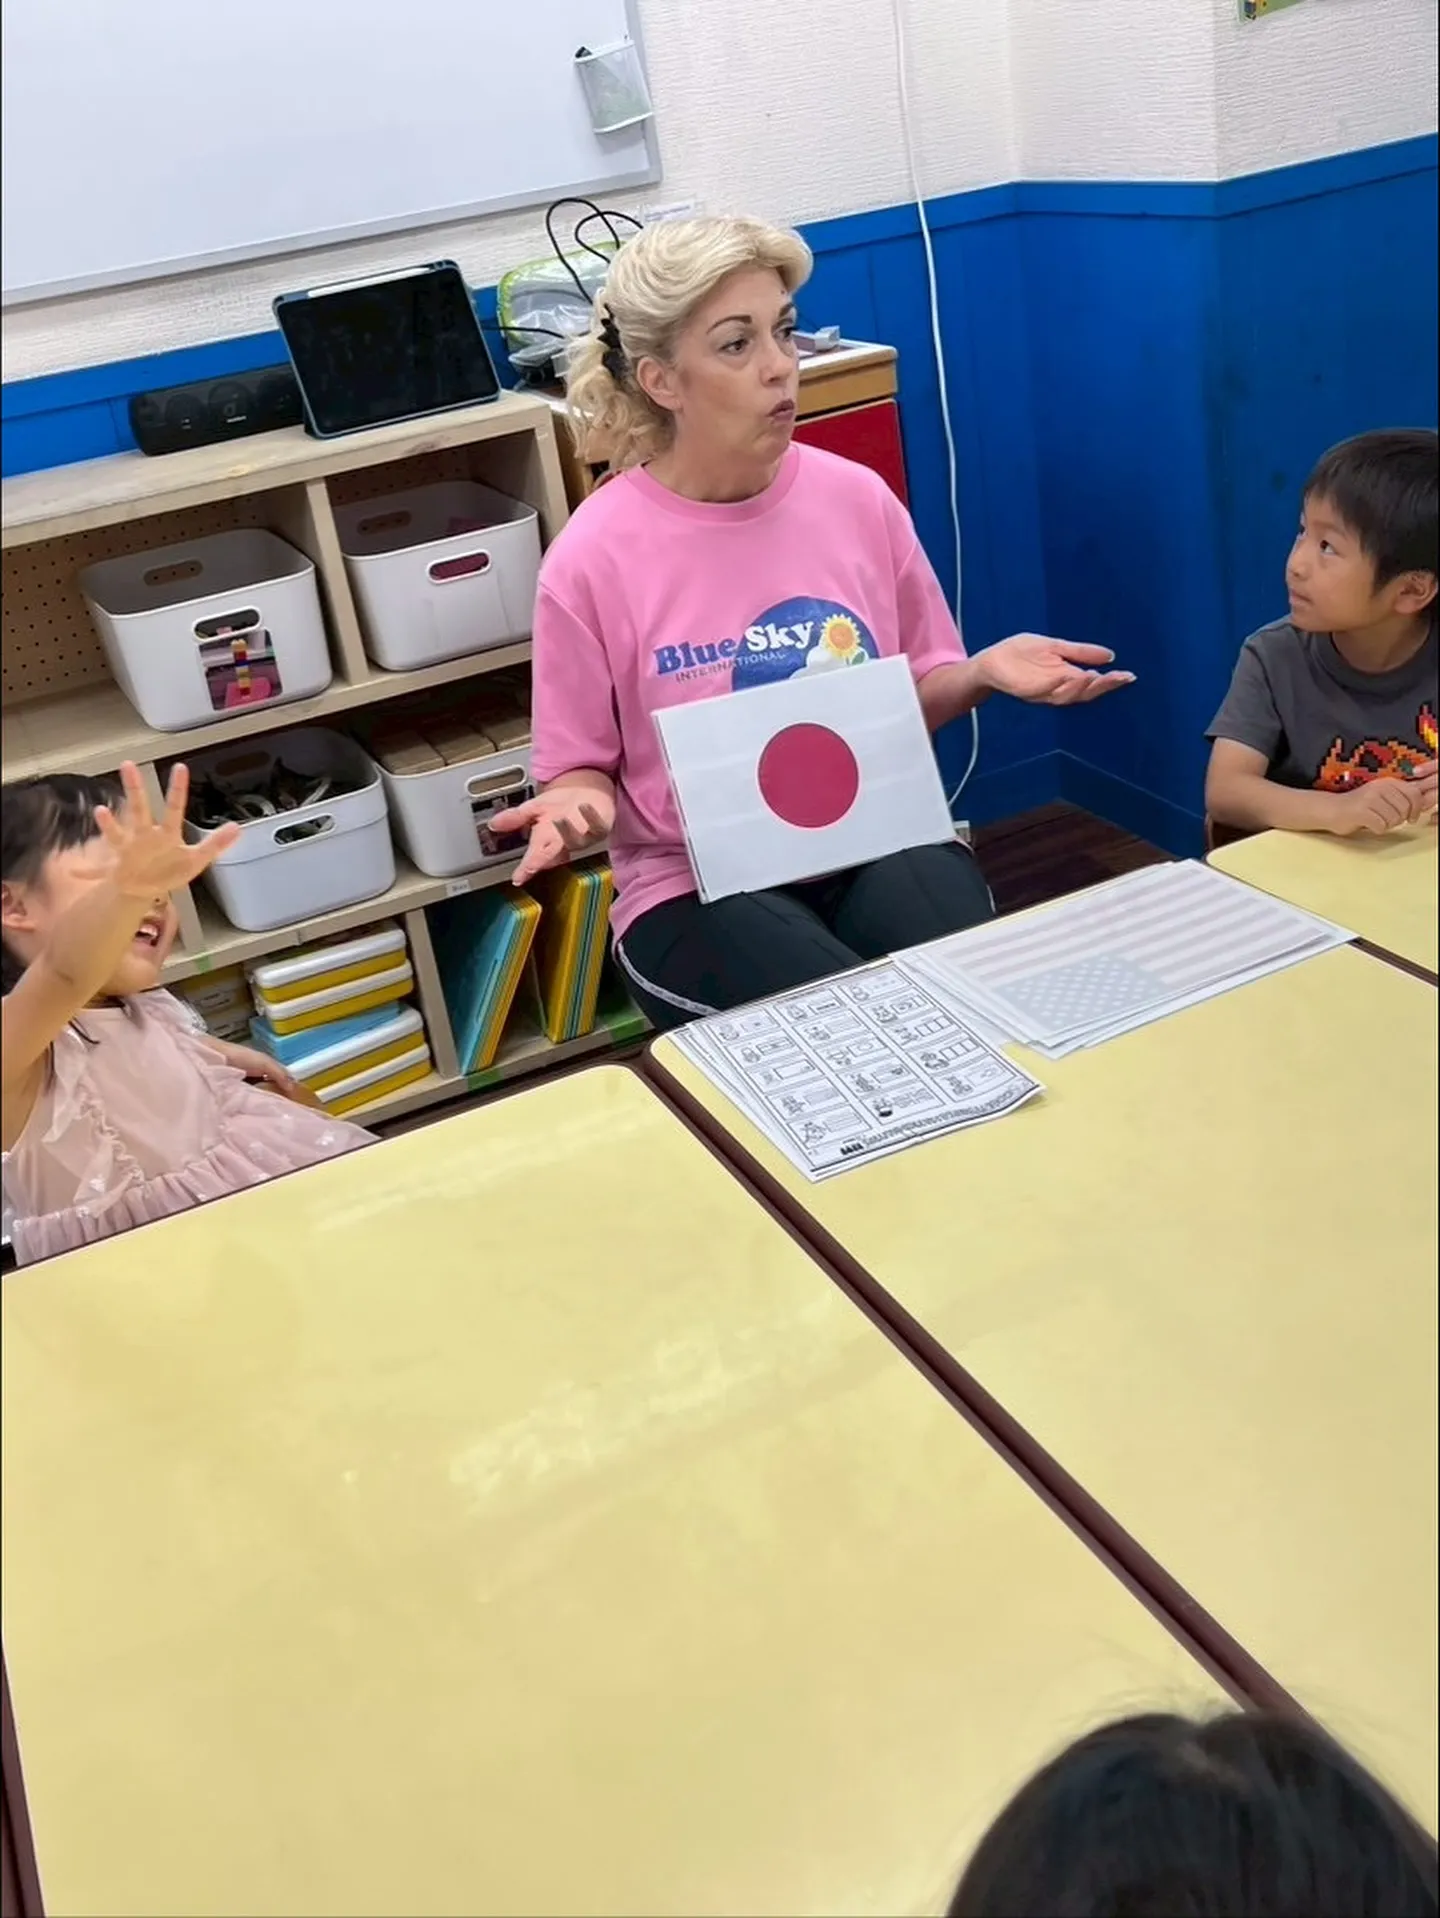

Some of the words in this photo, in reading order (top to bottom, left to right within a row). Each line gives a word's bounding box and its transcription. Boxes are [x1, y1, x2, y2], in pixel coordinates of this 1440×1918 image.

[653, 637, 738, 675] Blue
[744, 620, 815, 652] Sky
[675, 652, 786, 683] INTERNATIONAL
